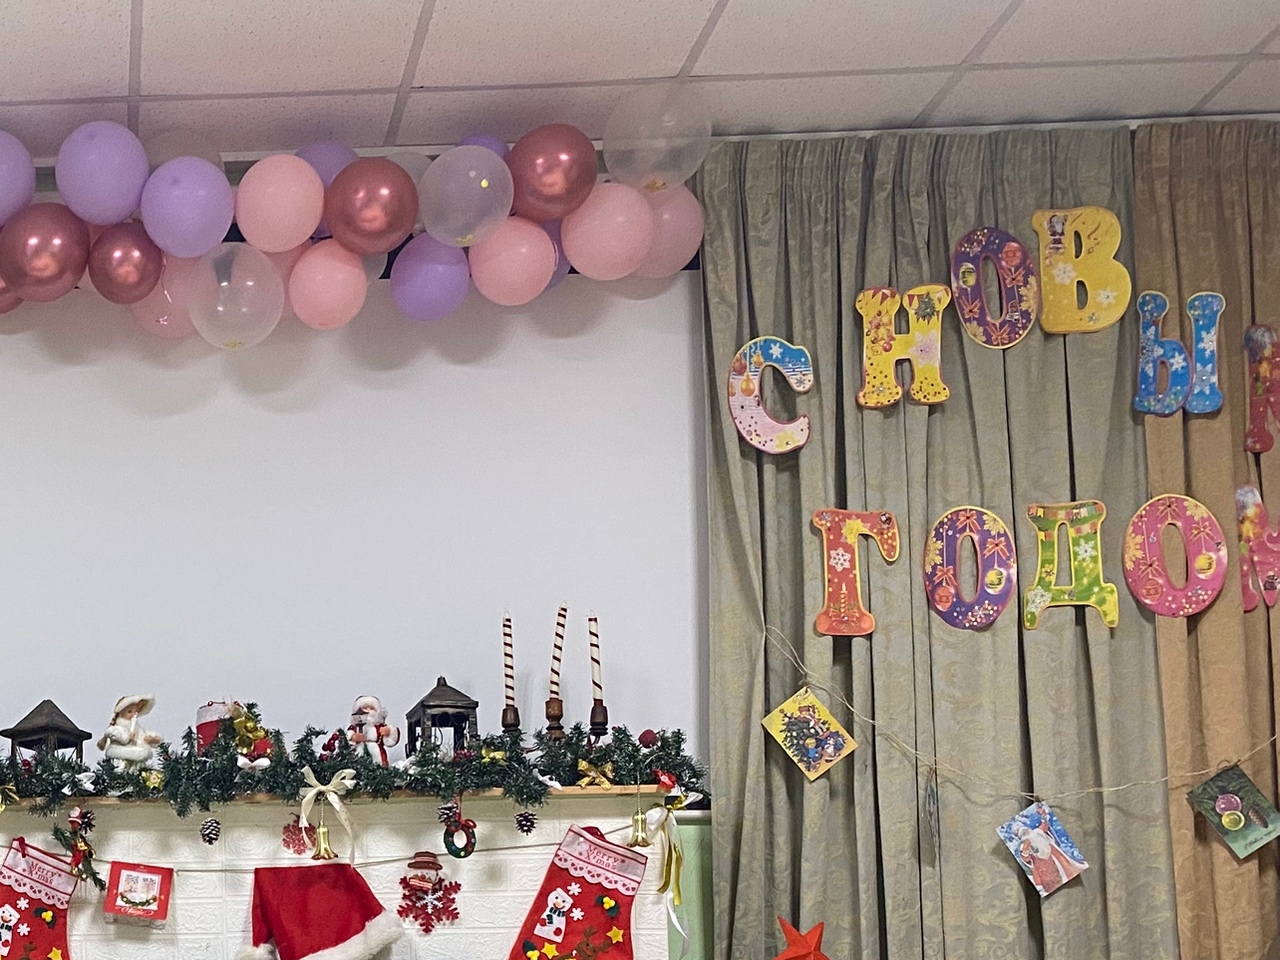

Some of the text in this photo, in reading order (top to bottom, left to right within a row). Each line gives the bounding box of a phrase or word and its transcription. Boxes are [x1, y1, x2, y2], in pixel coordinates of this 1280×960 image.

[728, 335, 815, 455] С
[585, 849, 617, 870] X'mas
[588, 844, 620, 863] Merry
[27, 866, 54, 885] X'mas
[30, 860, 57, 879] Merry
